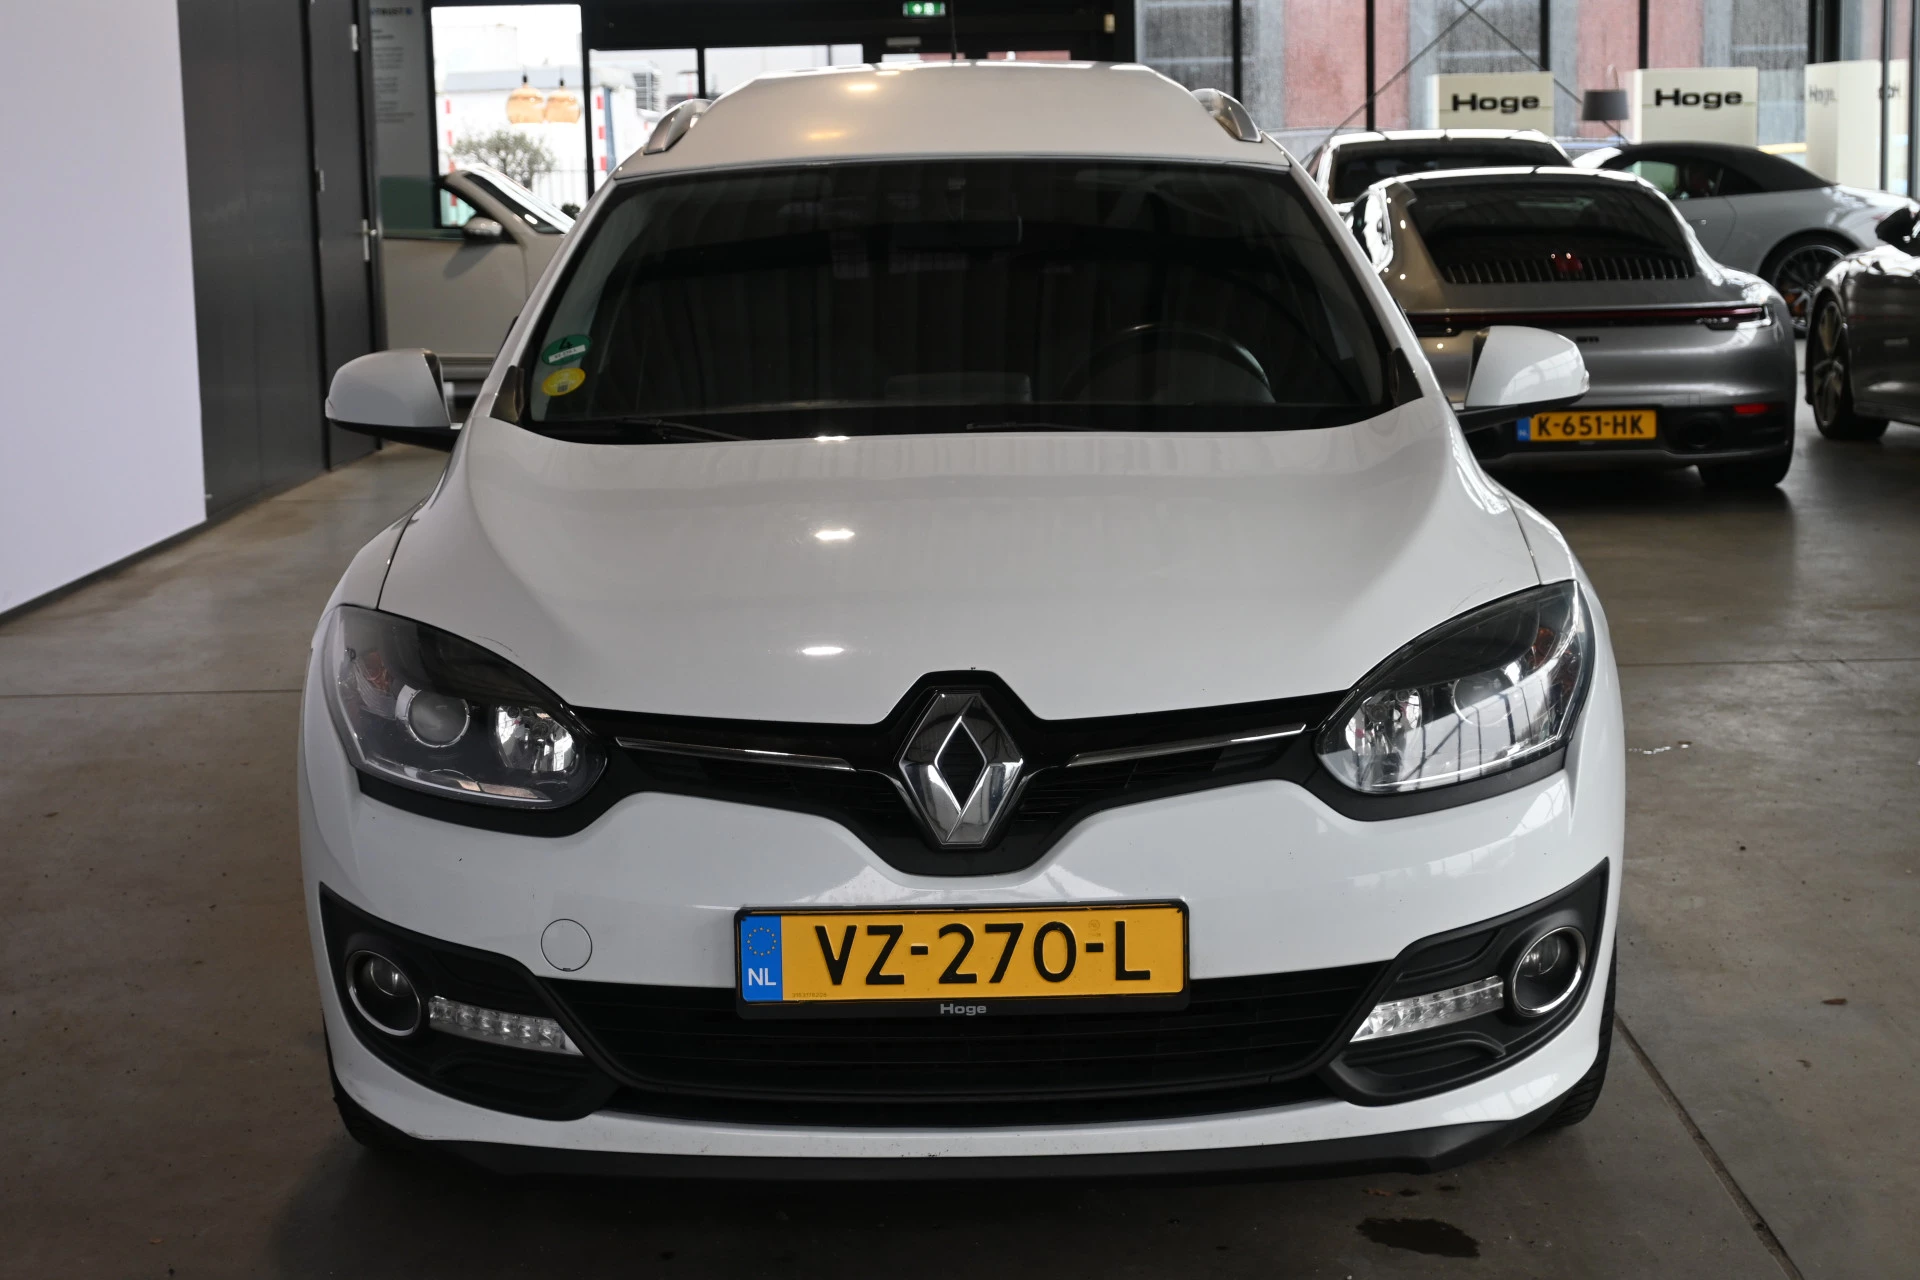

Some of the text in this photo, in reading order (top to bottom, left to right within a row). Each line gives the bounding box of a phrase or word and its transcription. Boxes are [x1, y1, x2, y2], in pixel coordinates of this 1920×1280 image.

[1452, 92, 1540, 115] Hoge
[1654, 87, 1743, 110] Hoge
[1537, 414, 1644, 437] K-651-HK
[814, 920, 1151, 986] VZ-270-L
[748, 967, 777, 986] NL
[939, 1002, 987, 1017] Hoge
